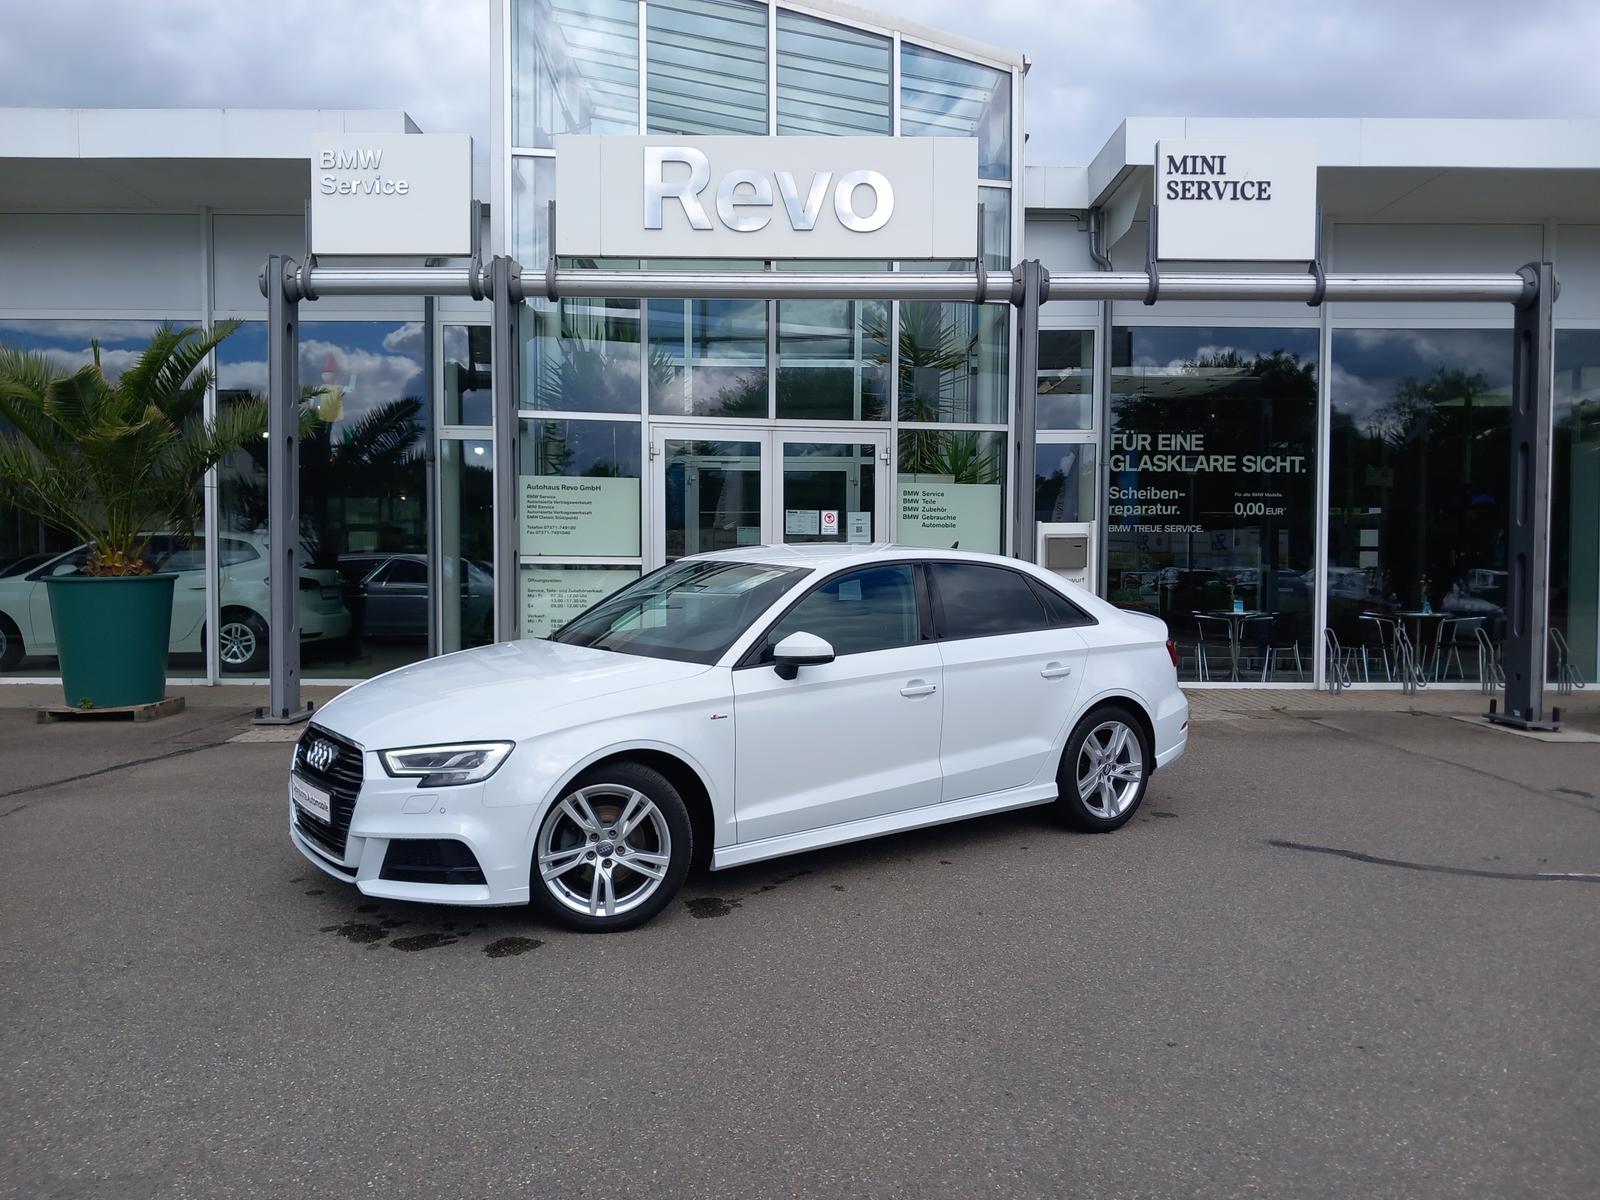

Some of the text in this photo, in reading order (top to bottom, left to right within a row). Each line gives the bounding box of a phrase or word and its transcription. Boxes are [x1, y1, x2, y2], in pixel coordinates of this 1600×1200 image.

[319, 149, 383, 170] BMW
[1166, 155, 1226, 175] MINI
[320, 174, 410, 195] Service
[644, 146, 895, 232] Revo
[1166, 180, 1271, 200] SERVICE
[1110, 430, 1204, 451] FÜR EINE
[1110, 454, 1306, 473] GLASKLARE SICHT.
[1109, 486, 1186, 500] Scheiben-
[1109, 503, 1180, 517] reparatur.
[1234, 502, 1264, 518] 0,00
[1108, 524, 1204, 533] BMW TREUE SERVICE.
